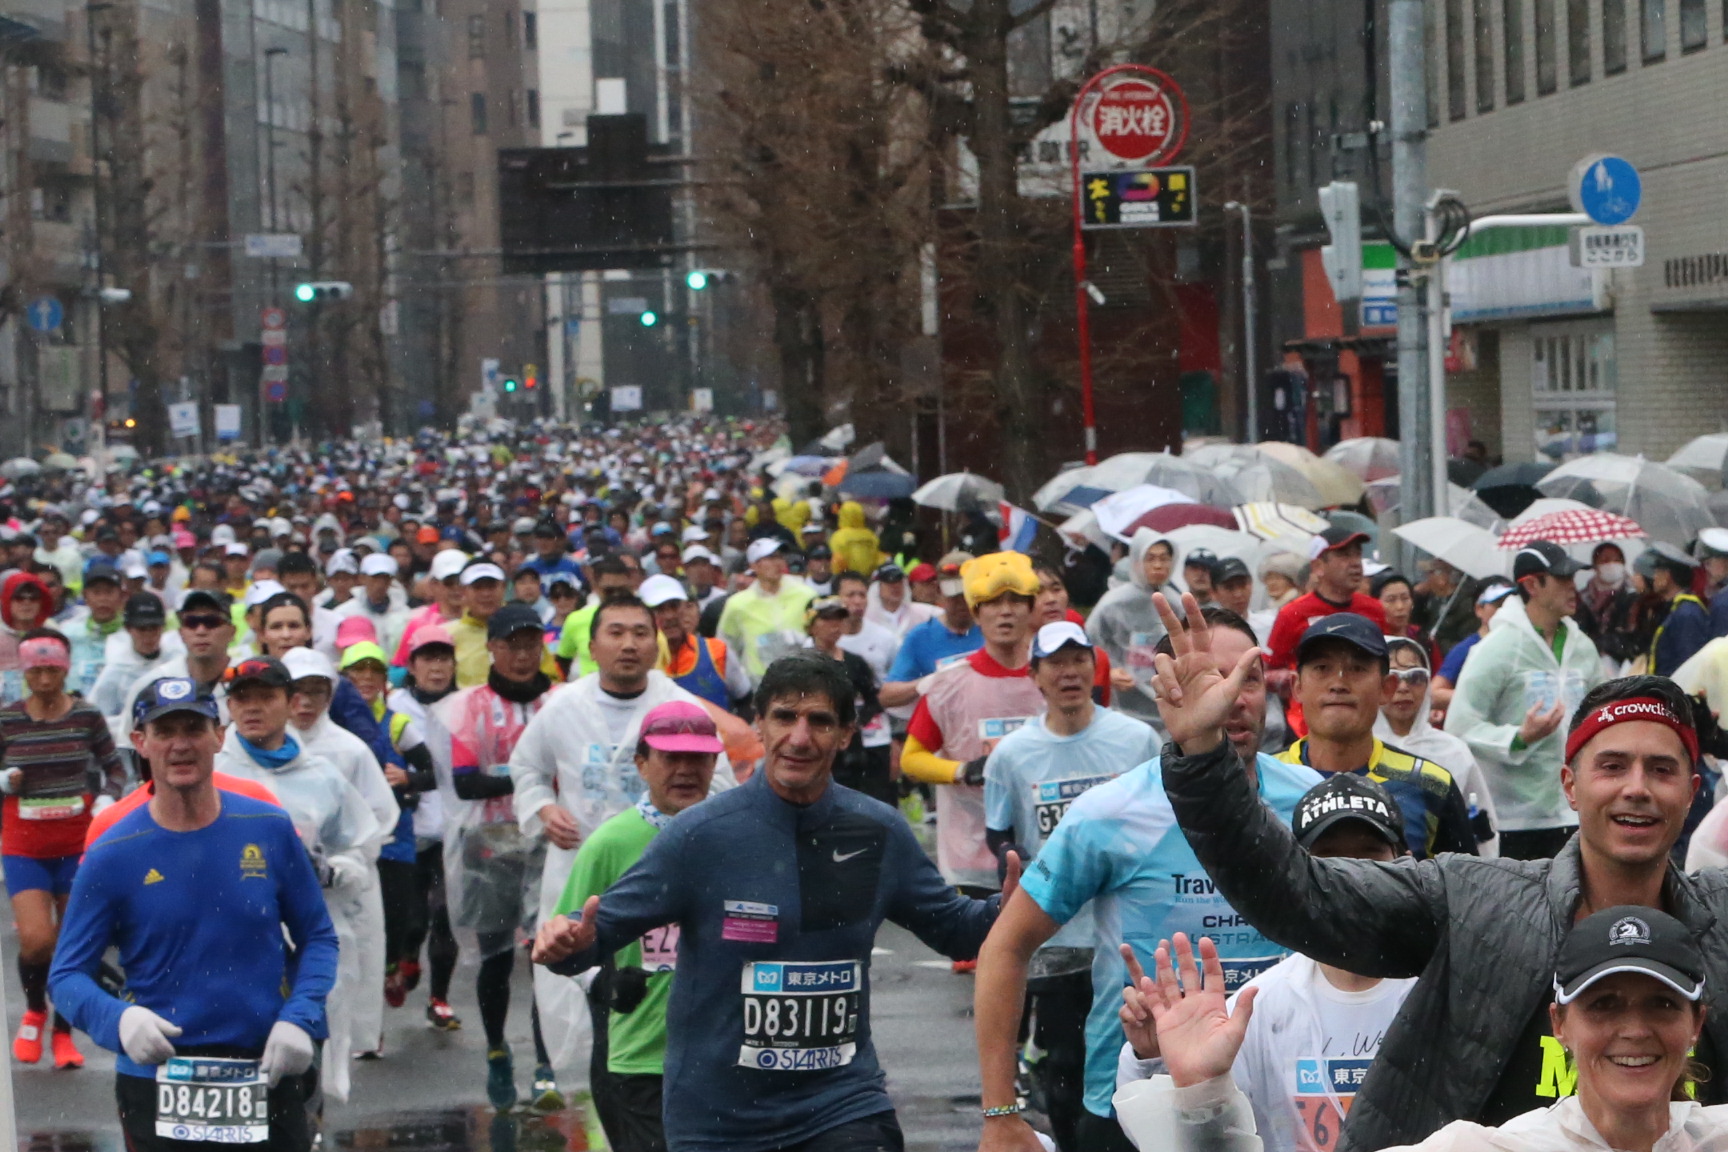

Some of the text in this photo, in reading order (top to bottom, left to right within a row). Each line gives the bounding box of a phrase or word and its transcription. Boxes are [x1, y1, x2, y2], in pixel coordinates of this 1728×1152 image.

[1099, 105, 1166, 137] 消火栓
[1301, 795, 1390, 829] ATHLETA
[787, 970, 851, 986] 東京メトロ
[744, 996, 848, 1037] D83119
[159, 1084, 253, 1118] D84218
